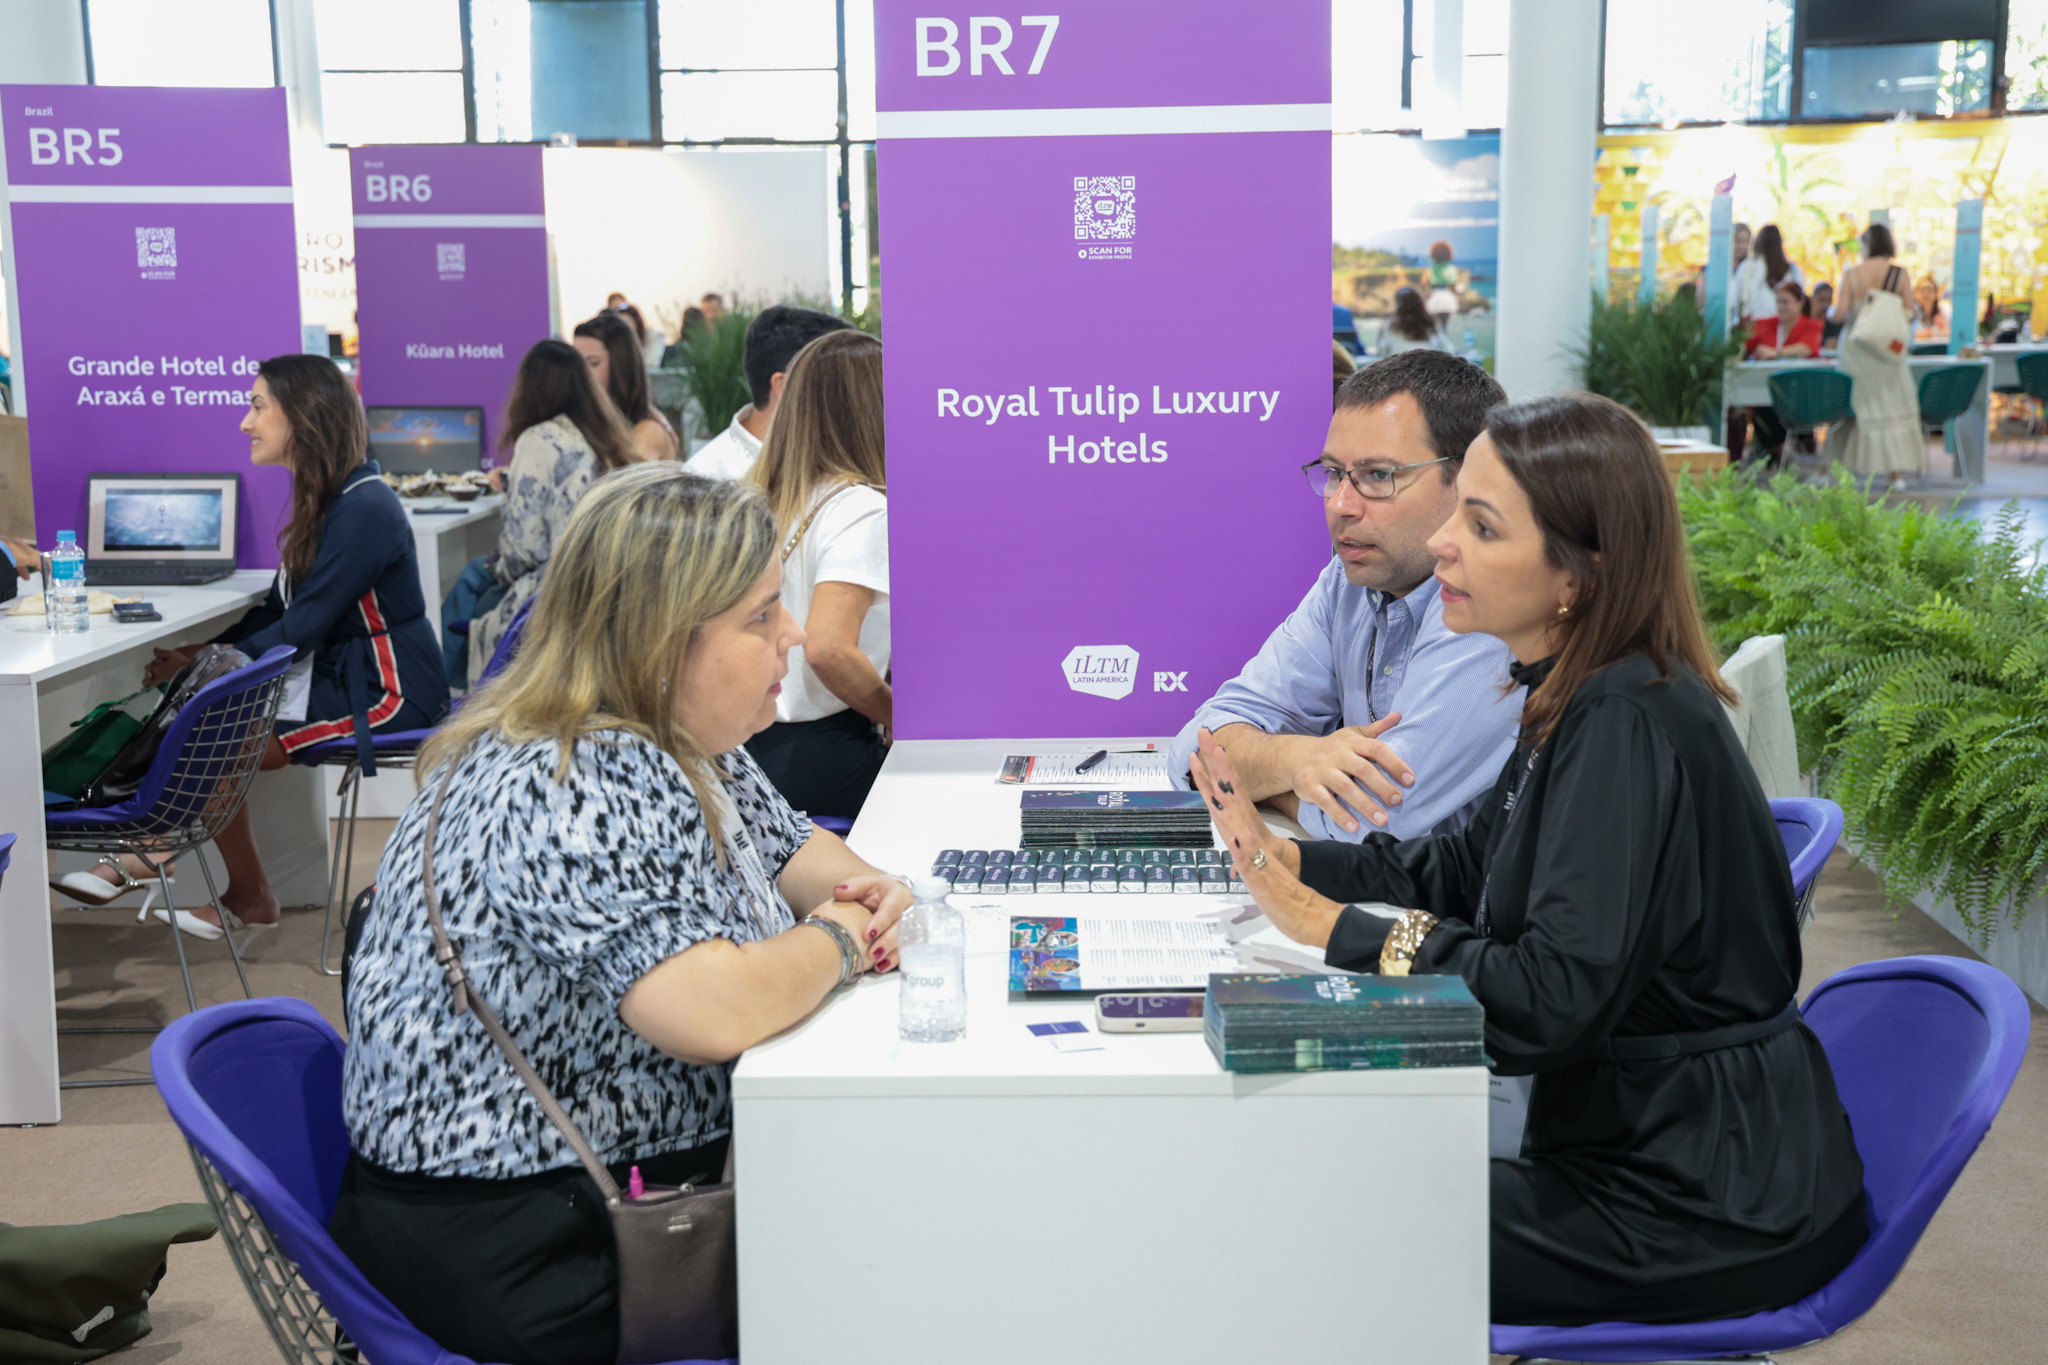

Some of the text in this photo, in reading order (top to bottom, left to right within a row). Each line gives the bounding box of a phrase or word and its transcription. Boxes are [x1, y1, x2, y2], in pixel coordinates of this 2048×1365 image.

[916, 15, 1059, 77] BR7
[25, 106, 54, 117] Brazil
[29, 127, 123, 167] BR5
[365, 173, 433, 203] BR6
[1088, 246, 1132, 255] SCAN FOR
[457, 342, 505, 359] Hotel
[68, 355, 260, 376] Grande Hotel de
[77, 386, 253, 406] Araxá e Termas
[938, 384, 1281, 425] Royal Tulip Luxury
[1047, 433, 1169, 464] Hotels
[1073, 655, 1131, 674] ILTM
[1096, 676, 1129, 684] AMERICA
[1153, 671, 1189, 692] RX
[909, 976, 945, 988] group
